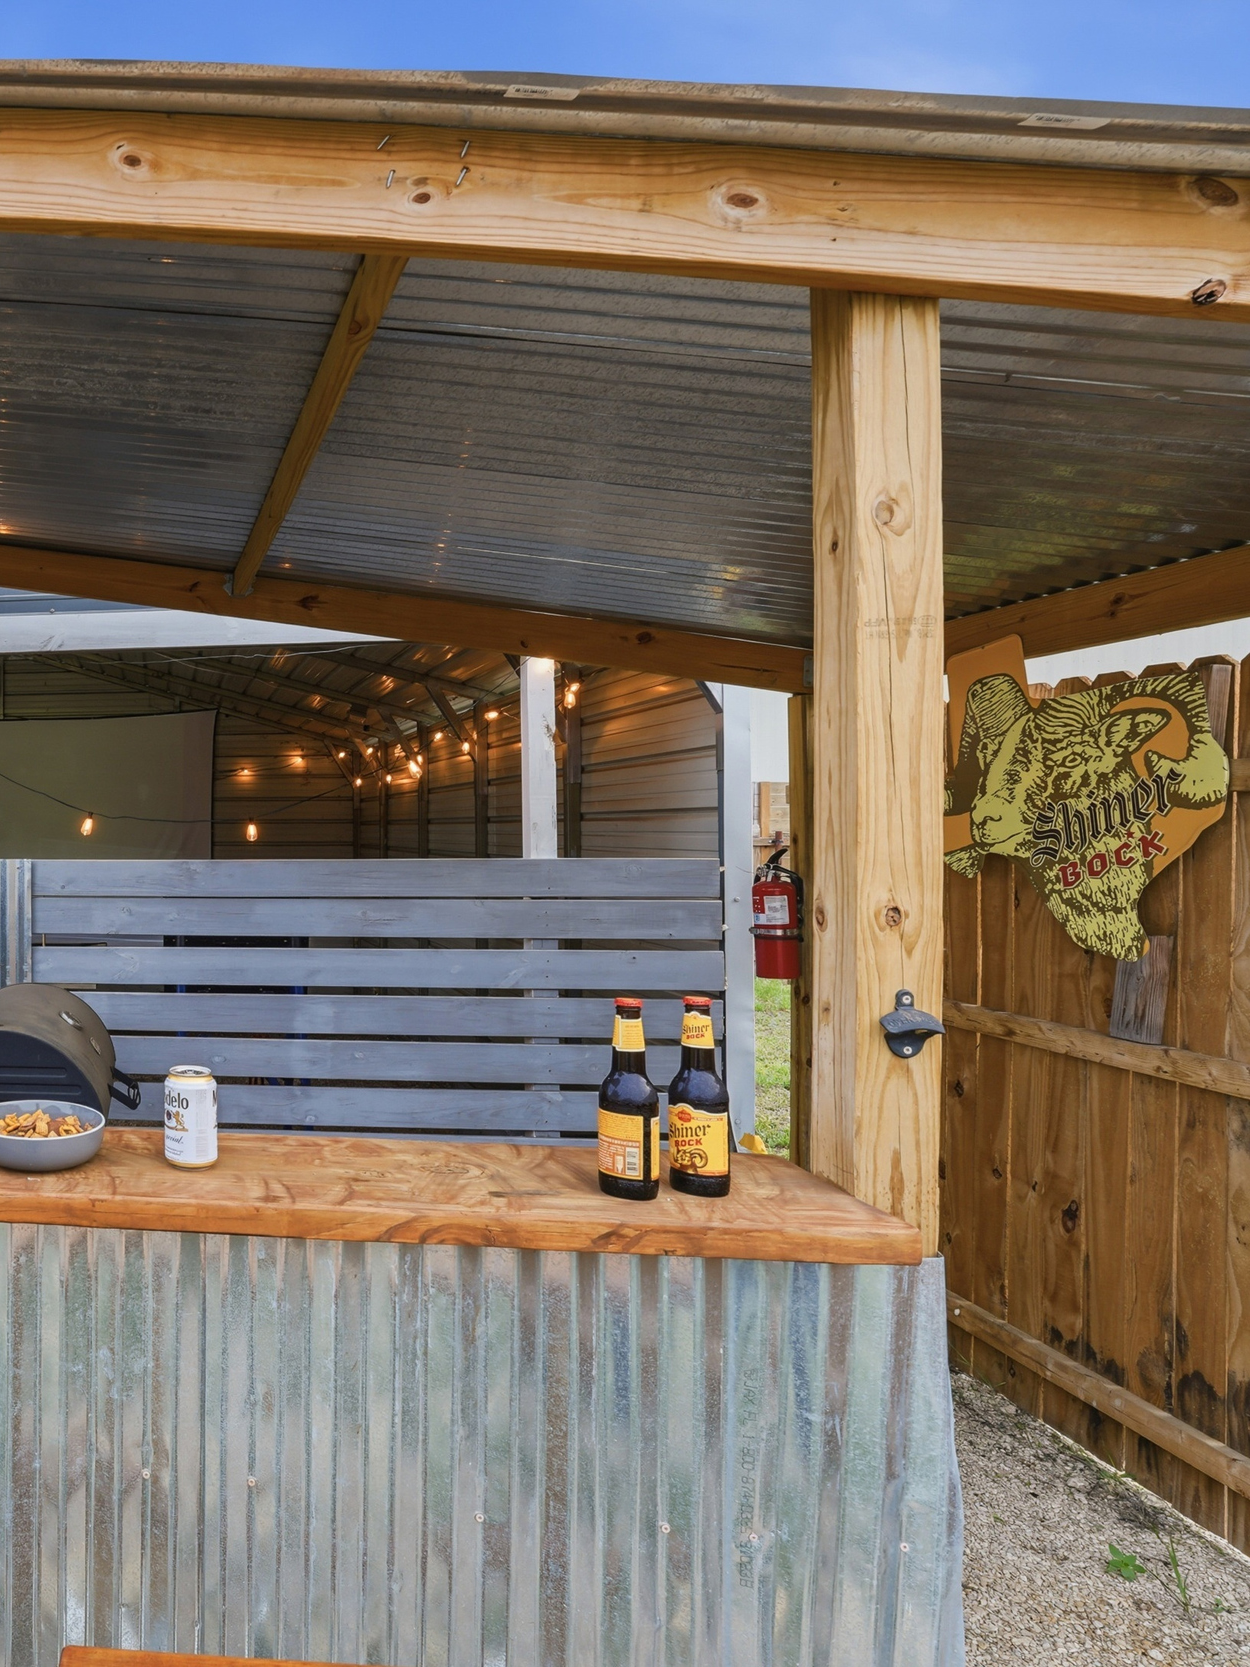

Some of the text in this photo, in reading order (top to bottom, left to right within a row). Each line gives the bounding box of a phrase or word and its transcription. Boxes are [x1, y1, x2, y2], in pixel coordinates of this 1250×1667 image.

[1029, 769, 1186, 867] Shiner
[1057, 830, 1168, 889] BOCK
[682, 1024, 710, 1035] Shiner
[164, 1090, 189, 1110] delo
[669, 1122, 712, 1139] Shiner
[675, 1138, 703, 1147] BOCK
